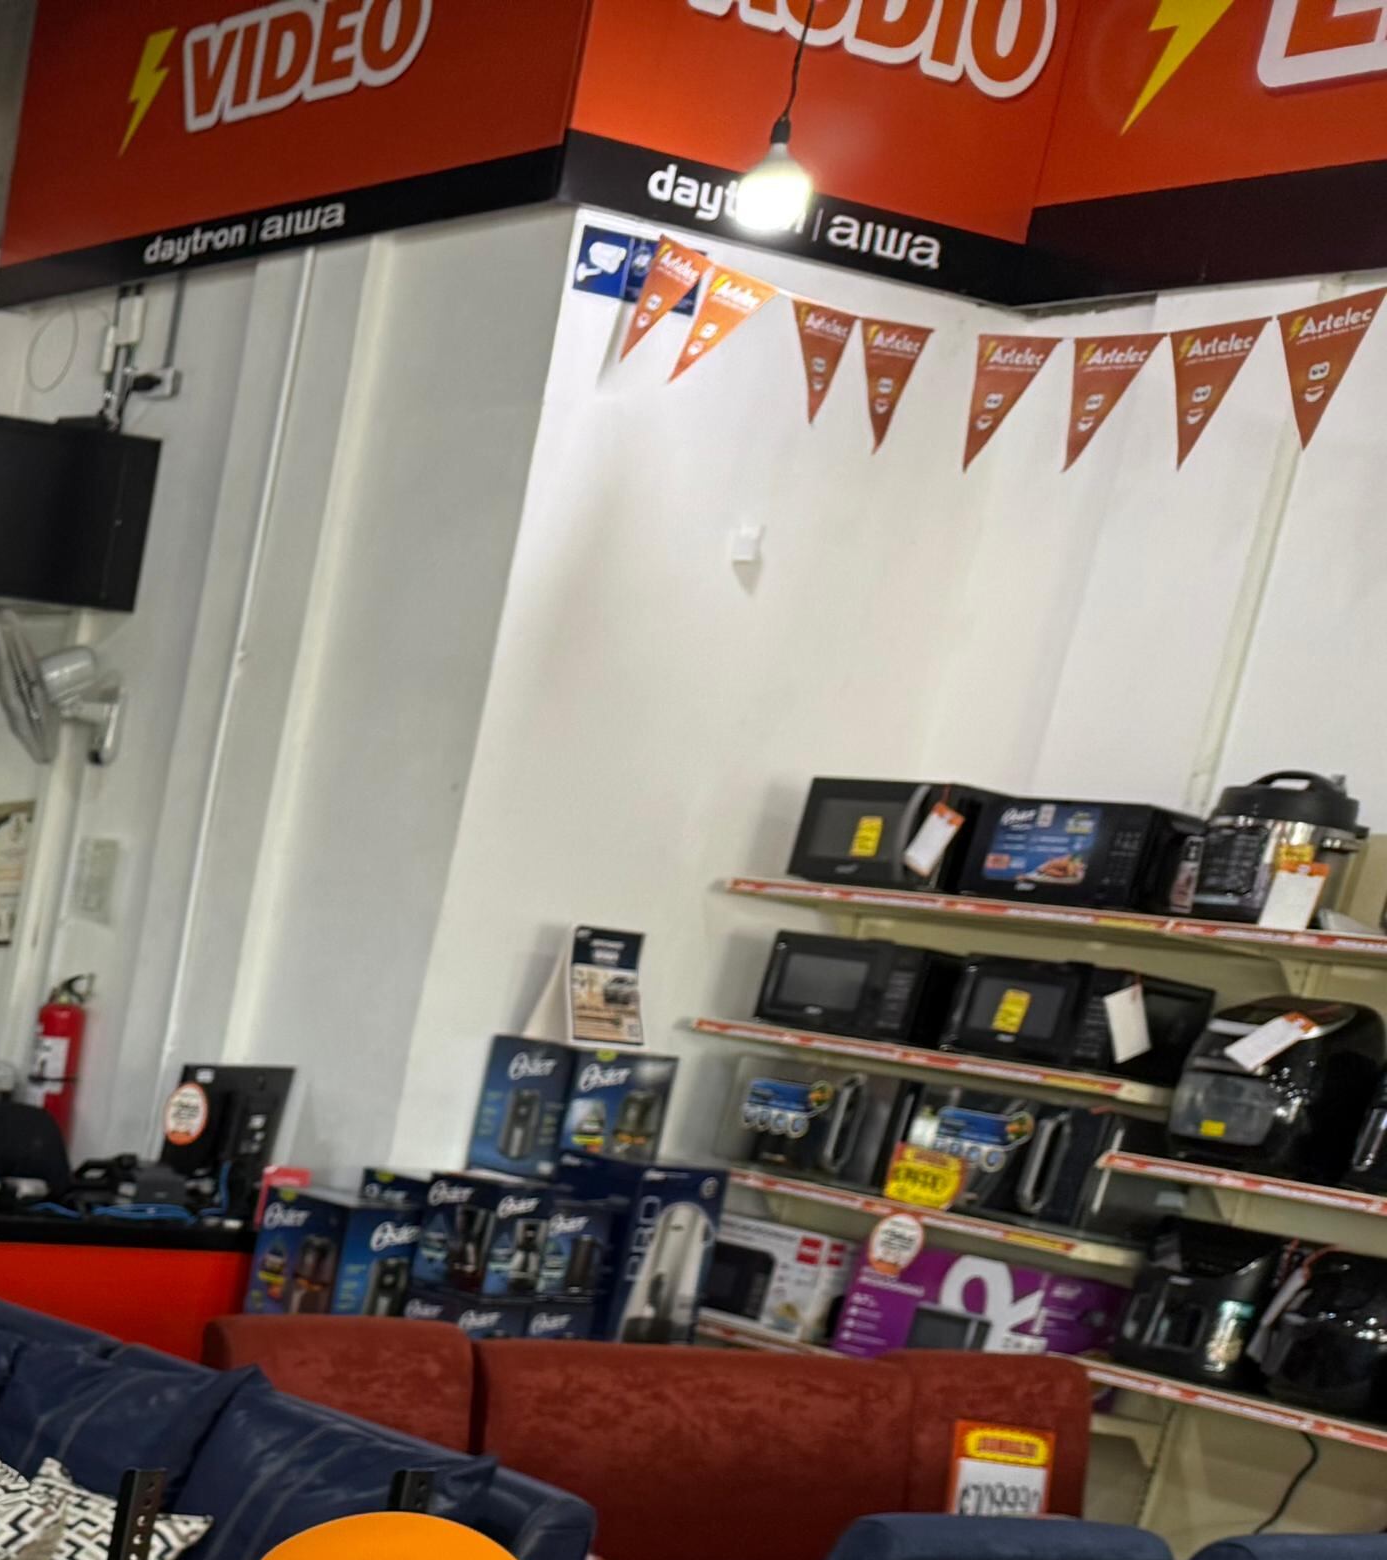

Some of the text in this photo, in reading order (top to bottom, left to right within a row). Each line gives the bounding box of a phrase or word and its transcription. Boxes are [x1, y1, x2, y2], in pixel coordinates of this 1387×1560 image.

[688, 0, 1058, 99] DIO
[182, 0, 429, 132] VIDEO
[143, 200, 347, 266] daytron aiwa
[827, 212, 944, 272] aiwa
[1296, 306, 1375, 338] Artelec
[989, 344, 1045, 367] Artelec
[1086, 344, 1149, 366] Artelec
[1187, 332, 1255, 359] Artelec
[508, 1050, 558, 1083] Oster
[579, 1062, 631, 1093] Oster
[263, 1202, 312, 1232] Oster
[496, 1195, 541, 1220] Oster
[370, 1220, 422, 1252] Oster
[548, 1213, 590, 1239] Oster
